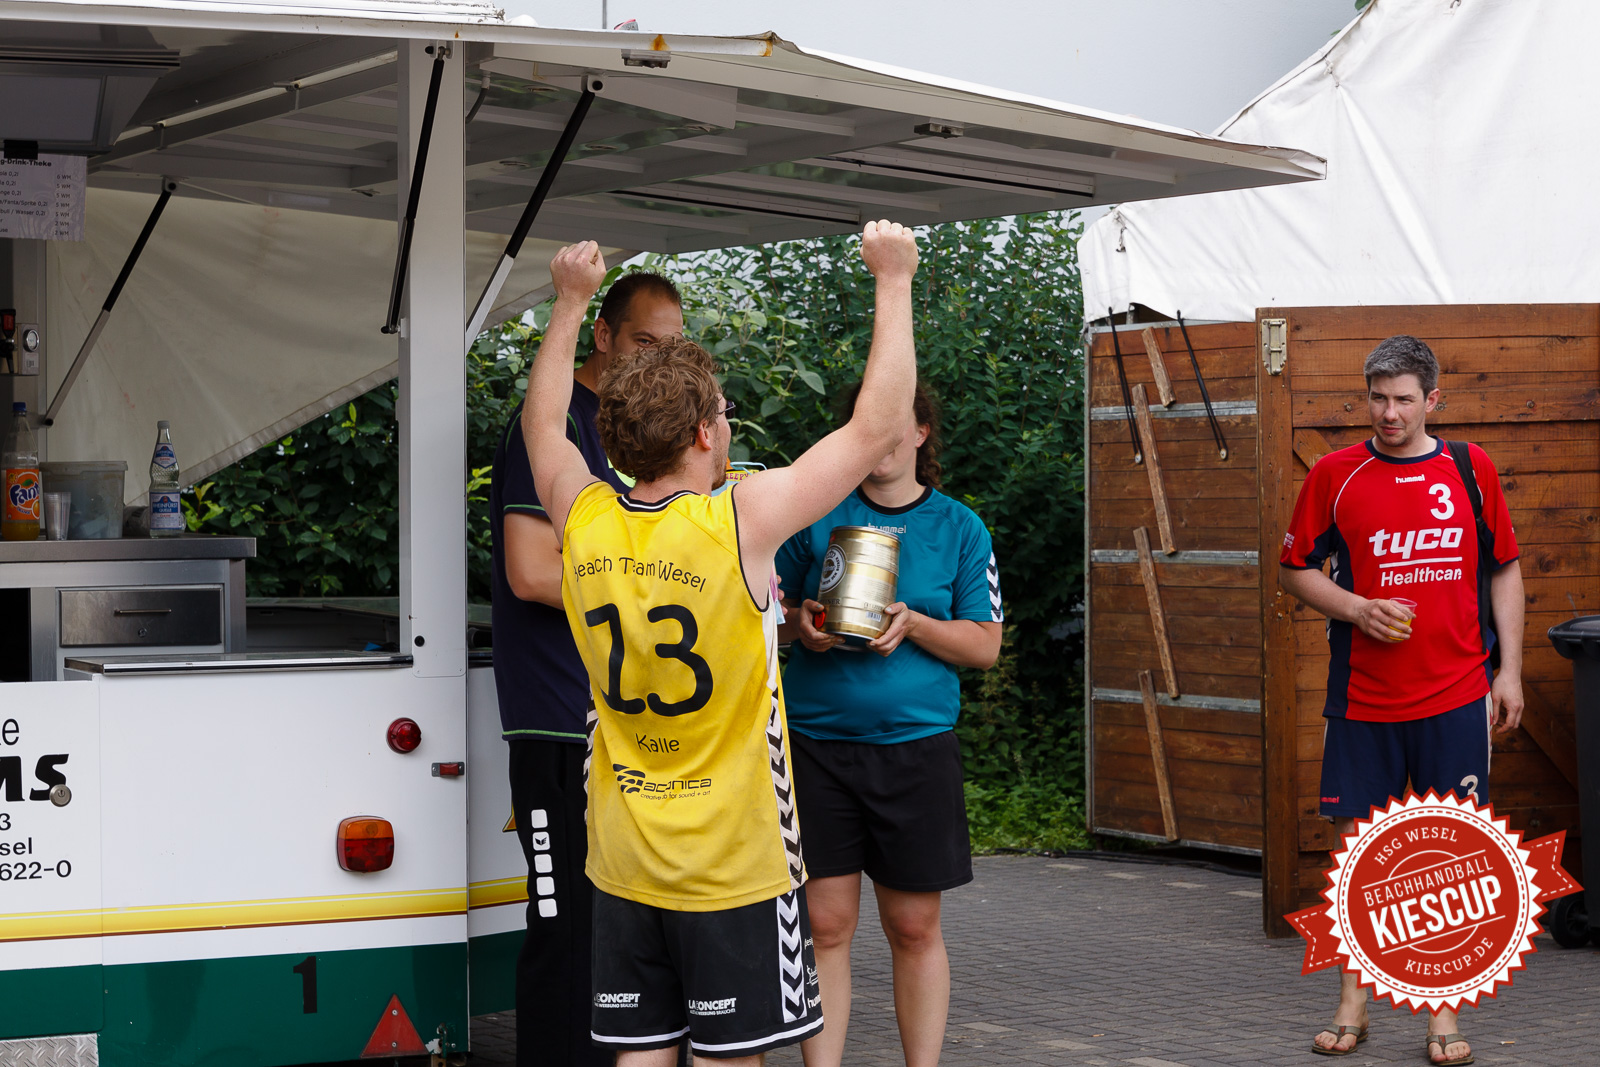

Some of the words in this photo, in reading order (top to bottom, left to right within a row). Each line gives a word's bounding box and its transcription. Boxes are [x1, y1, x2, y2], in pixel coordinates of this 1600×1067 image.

[1395, 473, 1426, 484] hummel
[1428, 483, 1455, 521] 3
[1368, 527, 1464, 560] tyco
[573, 556, 613, 583] each
[618, 557, 656, 577] Tam
[658, 560, 707, 593] Wesel
[584, 602, 714, 718] 13
[0, 718, 20, 746] e
[635, 732, 681, 754] Kalle
[0, 836, 33, 856] sel
[292, 955, 318, 1015] 1
